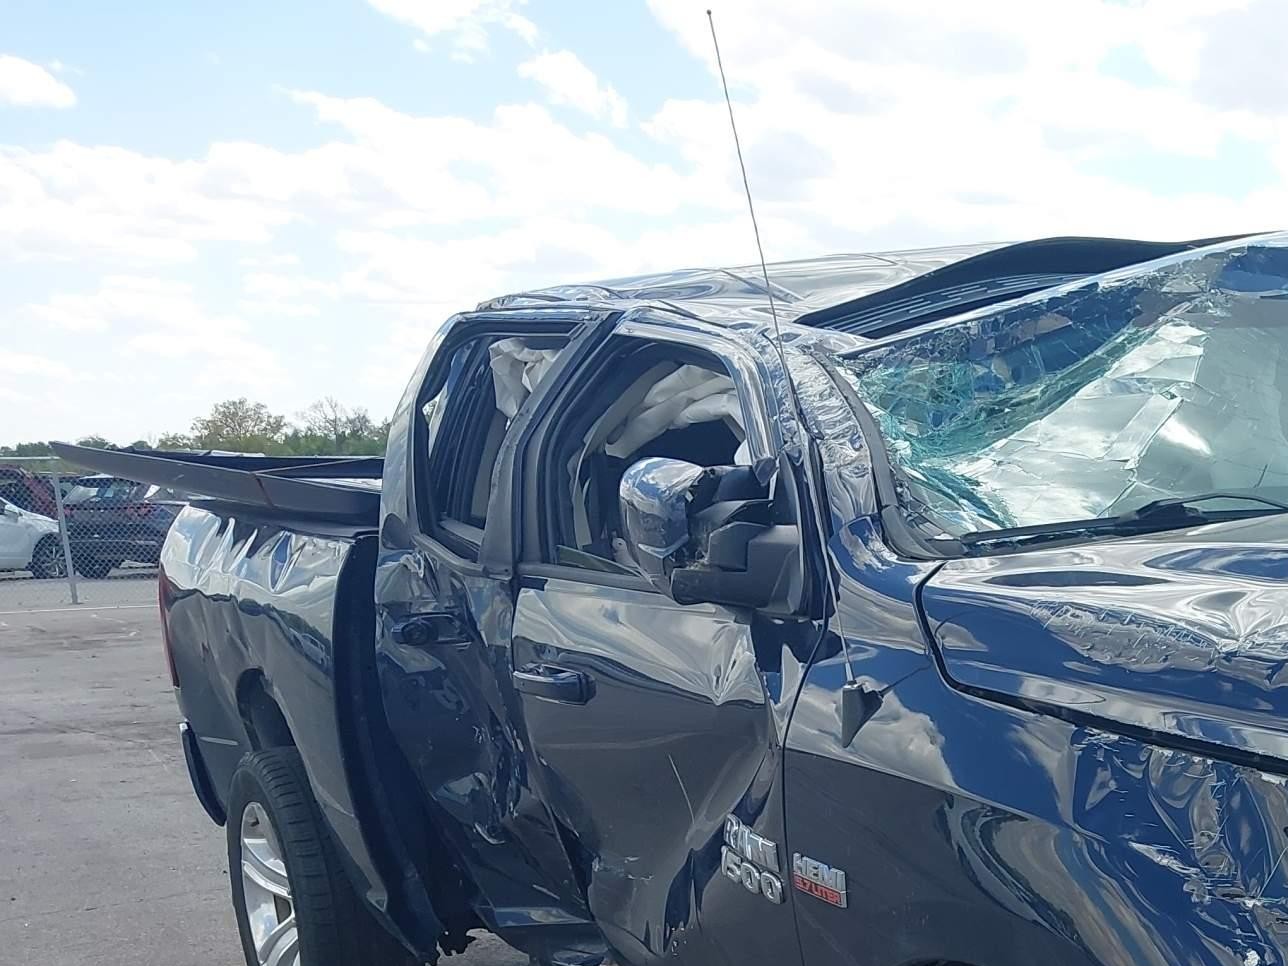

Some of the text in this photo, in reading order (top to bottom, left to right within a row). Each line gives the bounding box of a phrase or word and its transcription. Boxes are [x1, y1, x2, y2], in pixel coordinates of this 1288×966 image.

[723, 813, 780, 872] RAM
[721, 845, 784, 904] 1500
[793, 852, 846, 892] HEMI
[811, 884, 842, 905] LITER
